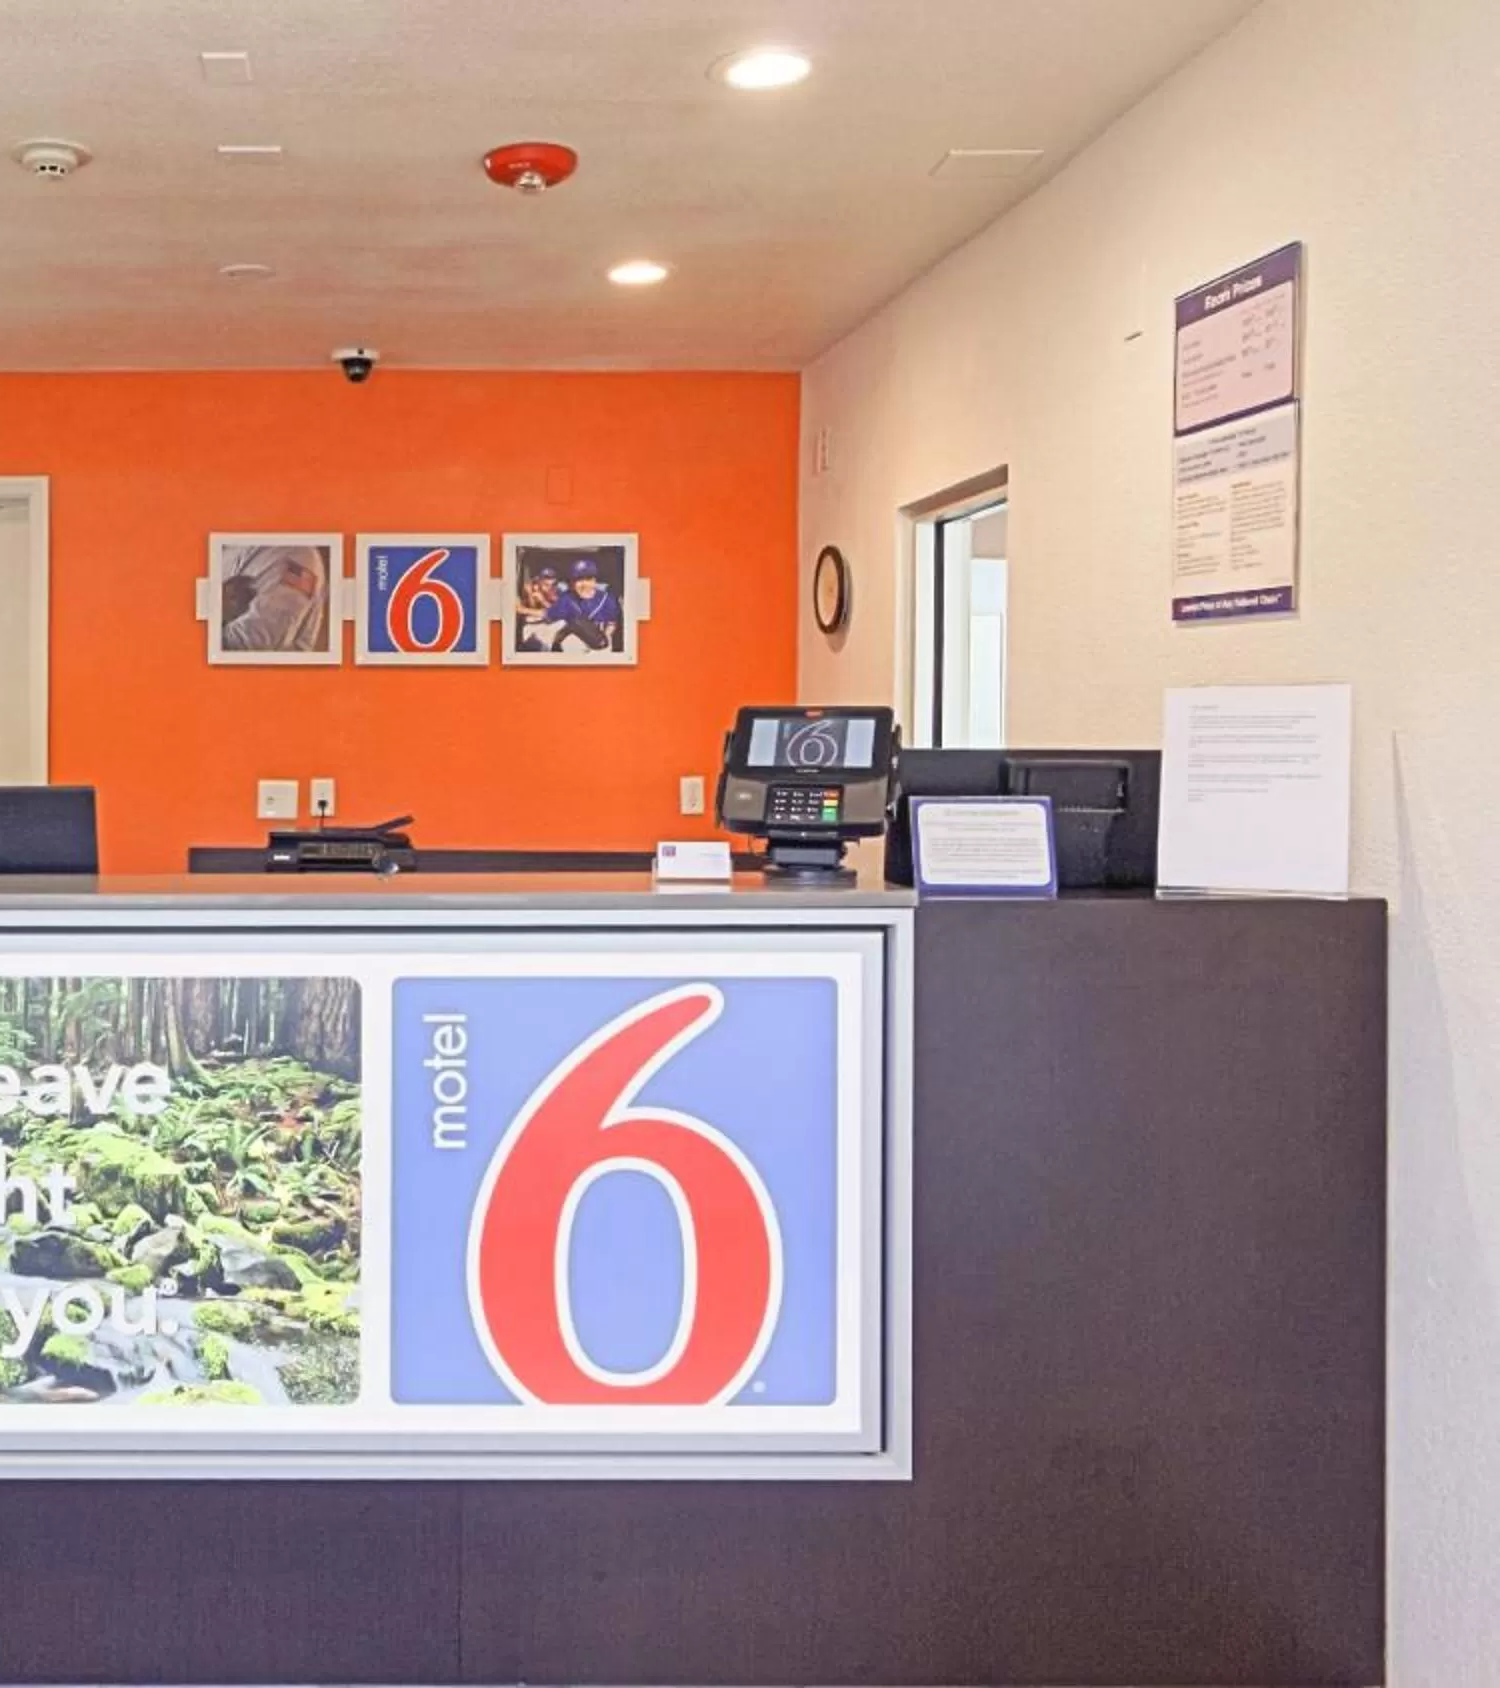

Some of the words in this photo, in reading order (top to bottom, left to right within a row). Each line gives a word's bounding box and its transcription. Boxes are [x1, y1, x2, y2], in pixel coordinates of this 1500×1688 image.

[386, 548, 464, 655] 6
[785, 719, 838, 767] 6
[422, 1013, 467, 1150] motel
[466, 982, 783, 1405] 6
